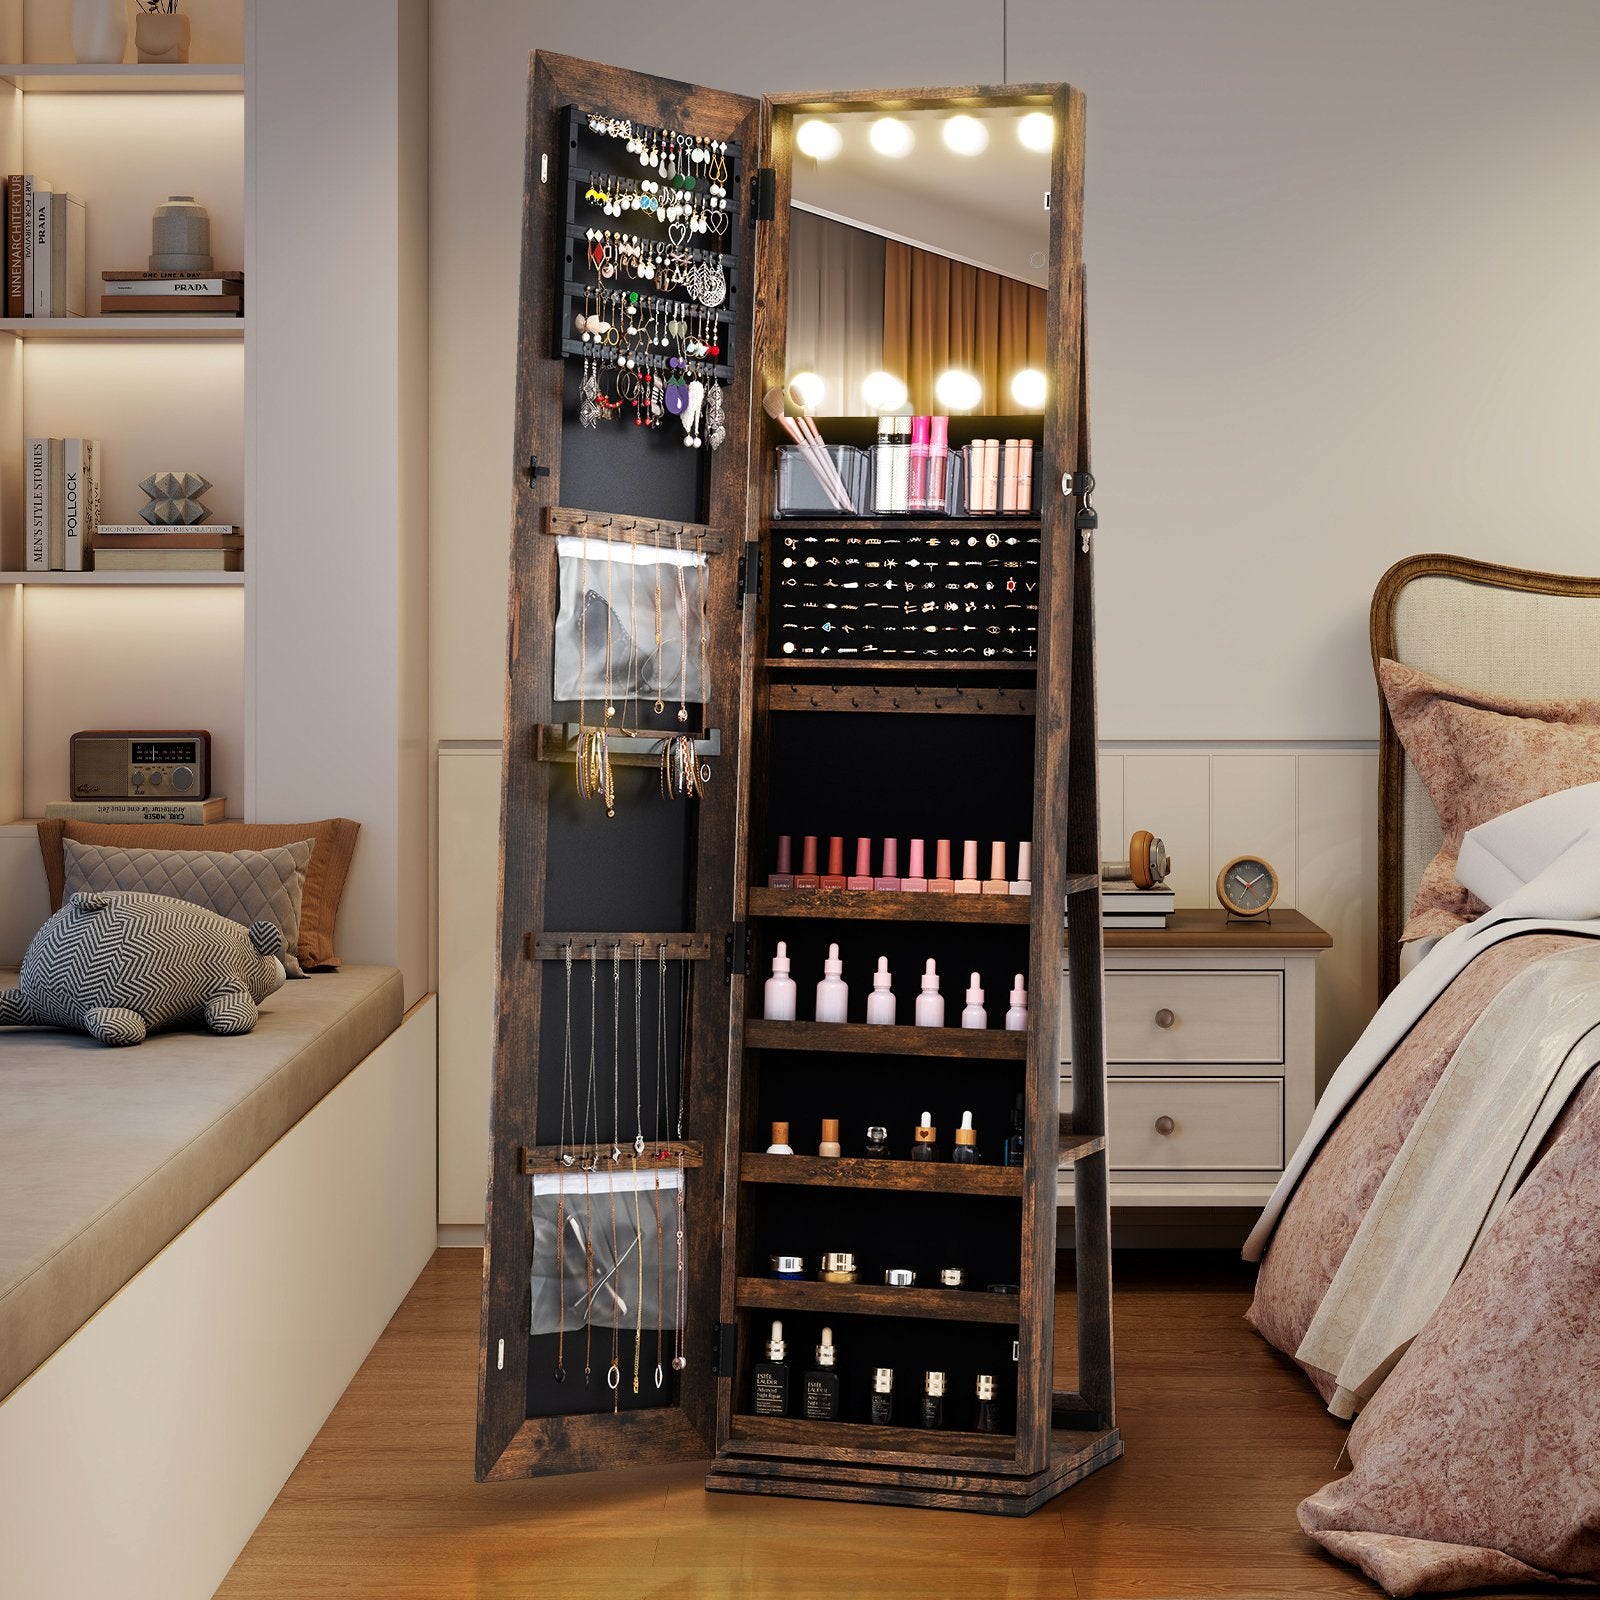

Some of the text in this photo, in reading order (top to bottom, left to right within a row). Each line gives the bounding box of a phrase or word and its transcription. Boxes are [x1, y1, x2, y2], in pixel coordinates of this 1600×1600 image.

[12, 175, 22, 297] INNENARCHITEKTUR
[38, 206, 46, 244] PRADA
[33, 443, 43, 563] MEN'S STYLE STORIES
[67, 472, 77, 537] POLLOCK
